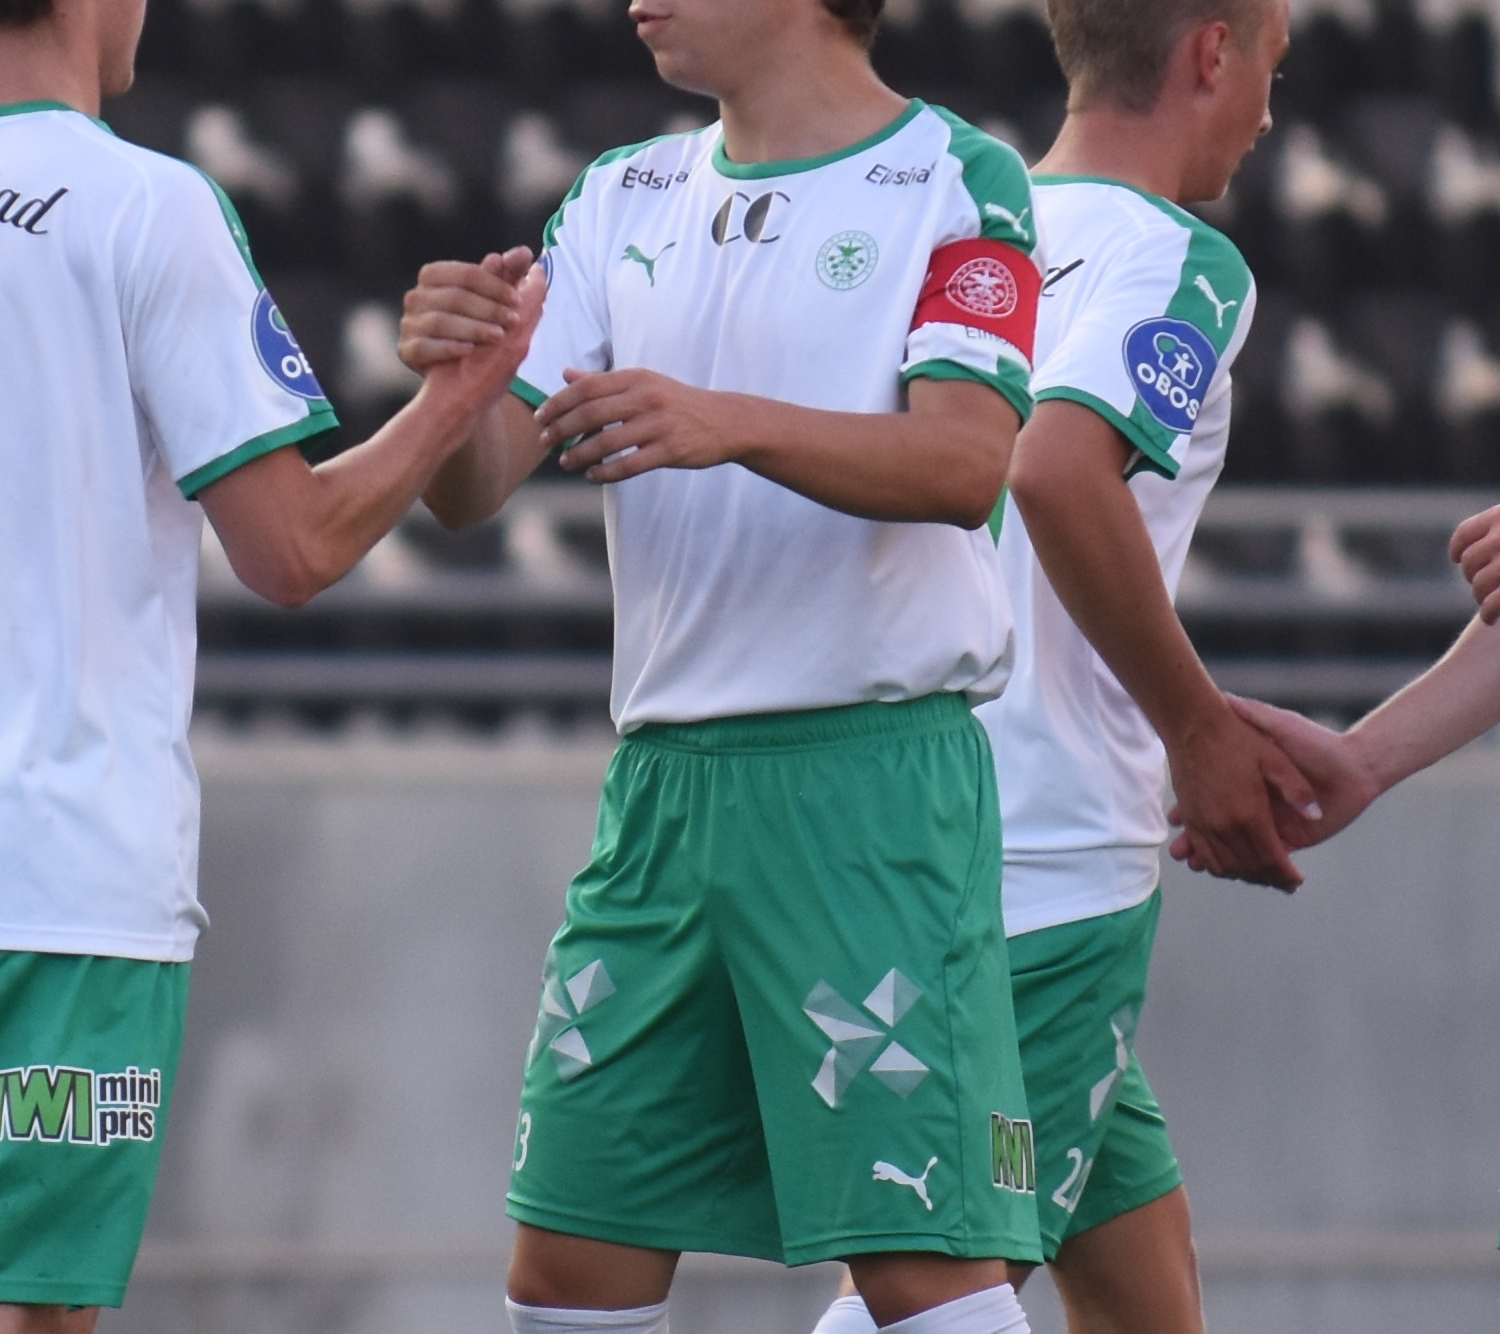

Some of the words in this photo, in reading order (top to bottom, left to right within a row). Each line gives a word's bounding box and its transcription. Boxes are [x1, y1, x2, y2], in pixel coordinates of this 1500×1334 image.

[621, 165, 689, 190] Edsia
[1136, 362, 1201, 421] OBOS
[99, 1067, 160, 1106] mini
[99, 1104, 155, 1145] pris
